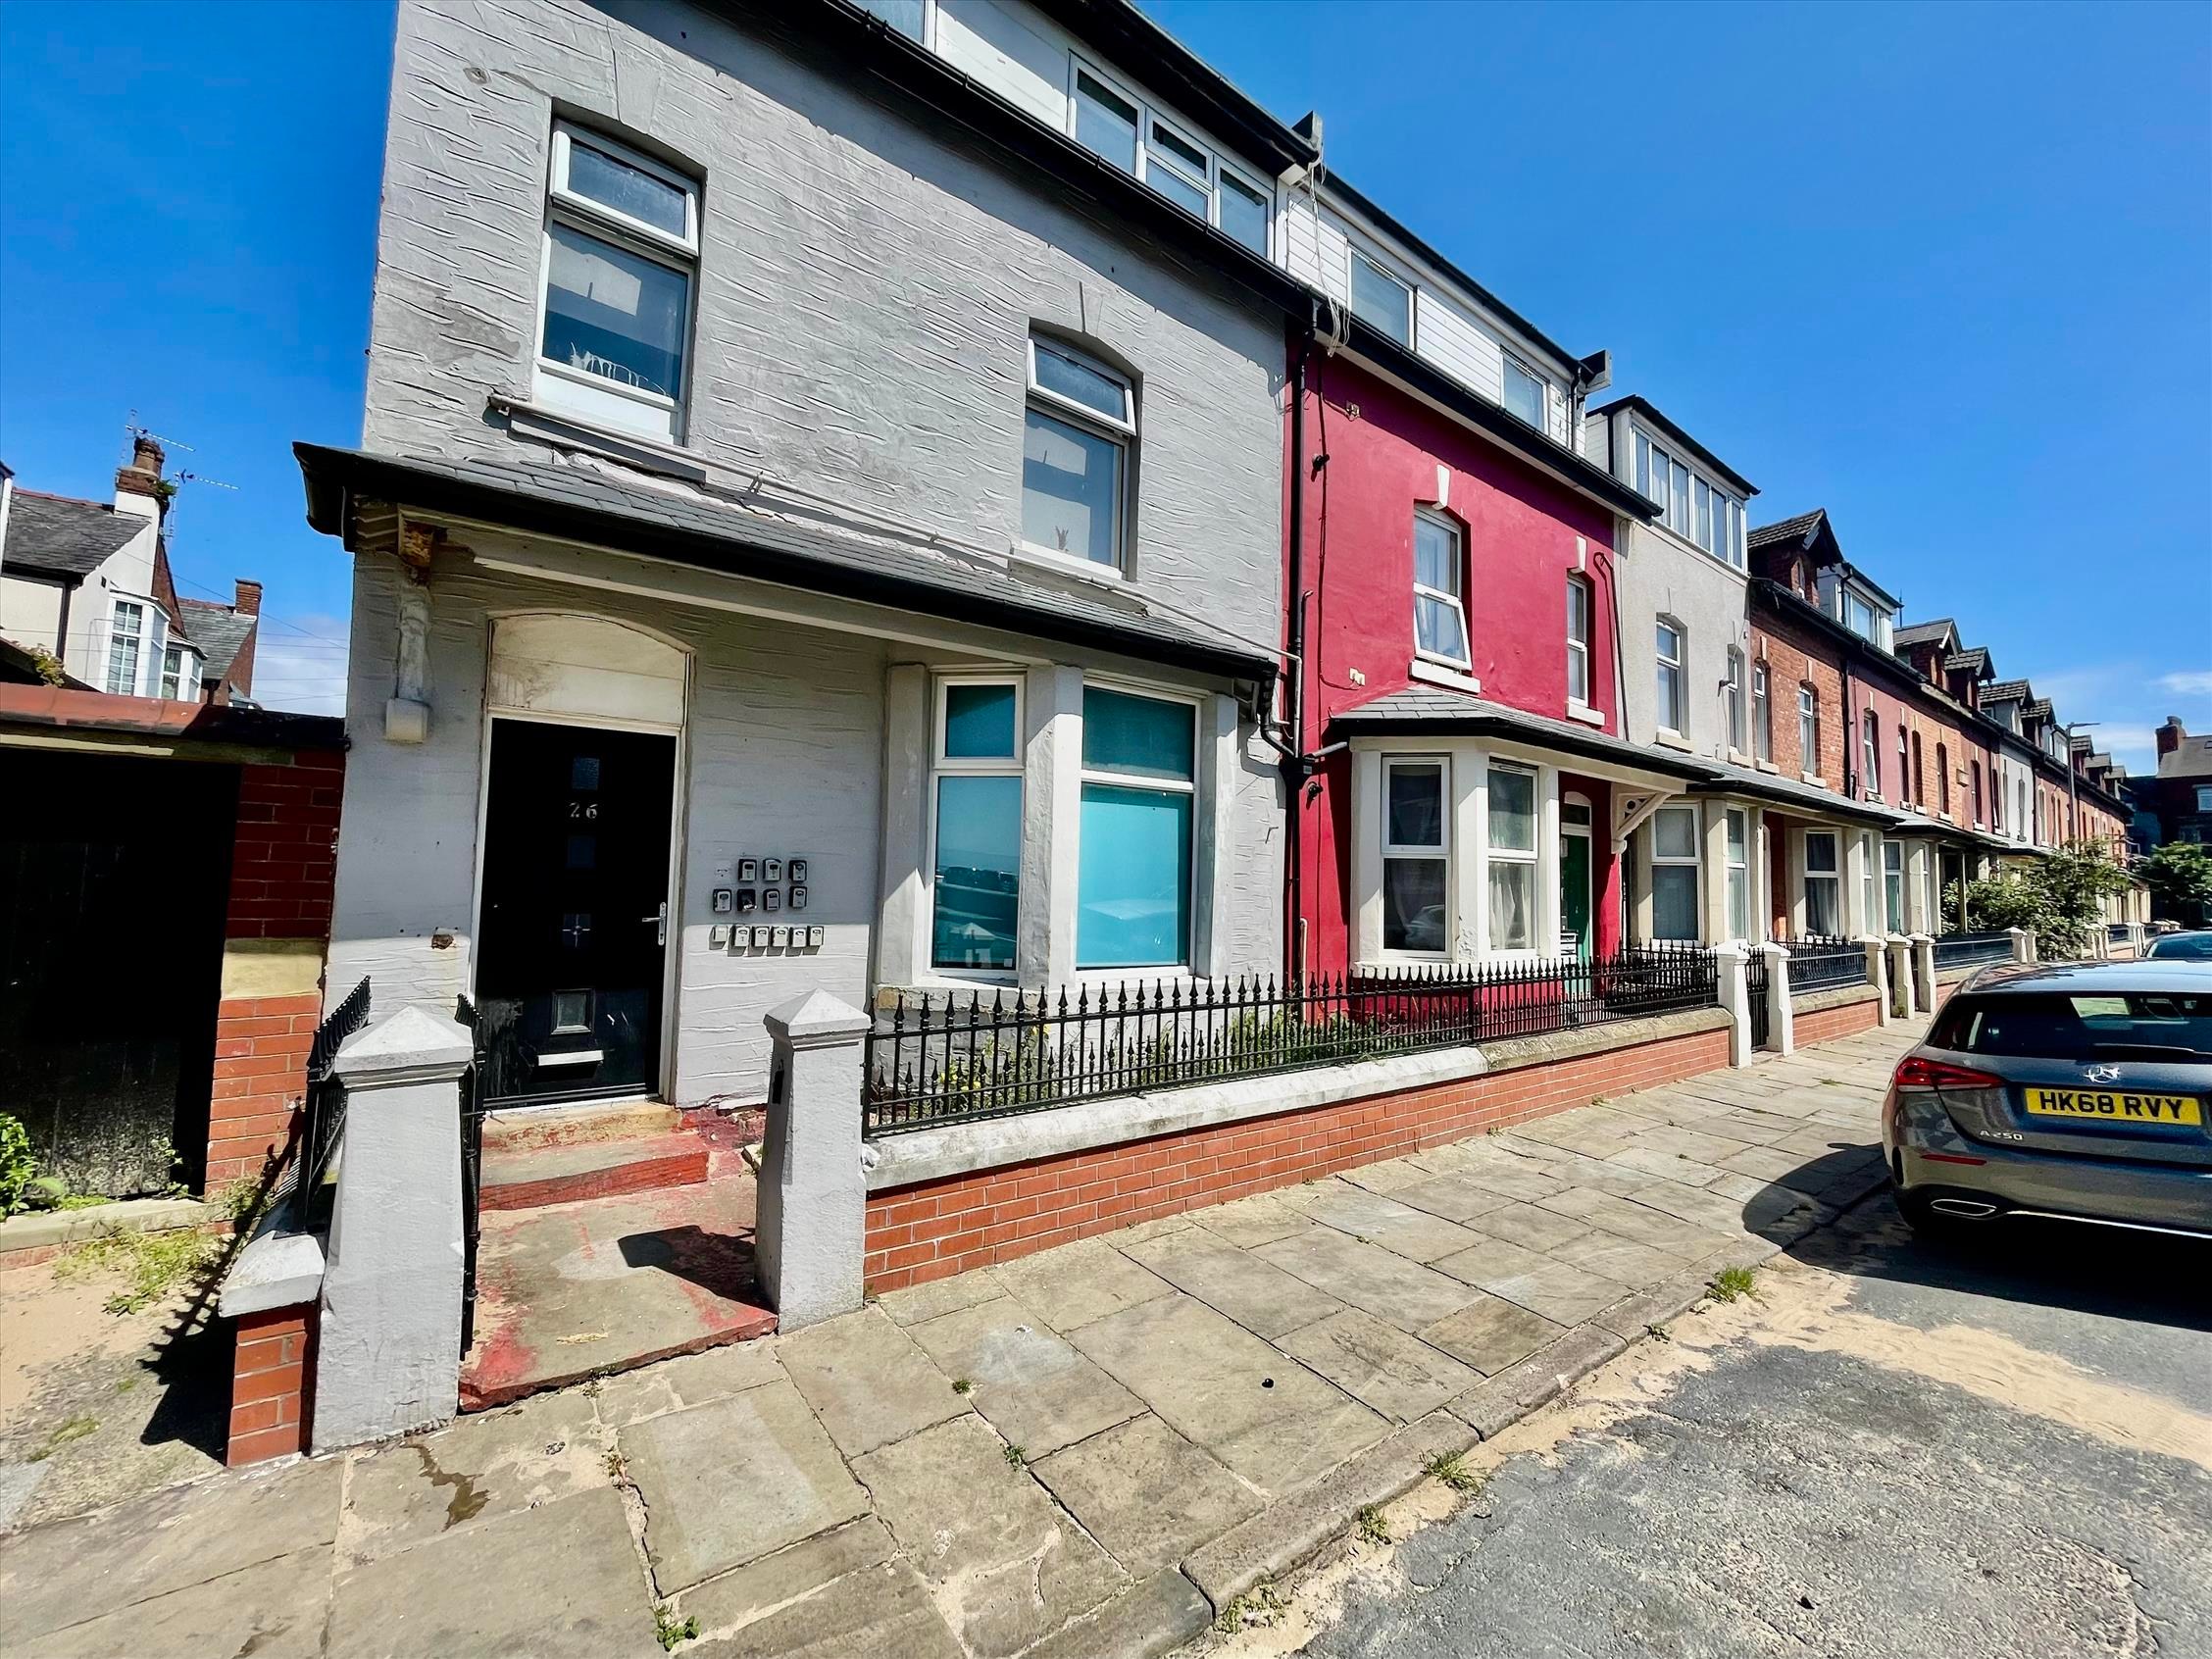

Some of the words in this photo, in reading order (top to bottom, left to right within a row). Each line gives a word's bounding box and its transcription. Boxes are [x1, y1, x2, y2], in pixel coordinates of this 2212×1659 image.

[569, 802, 598, 819] 26
[2038, 1090, 2116, 1115] HK68
[2123, 1095, 2183, 1120] RVY
